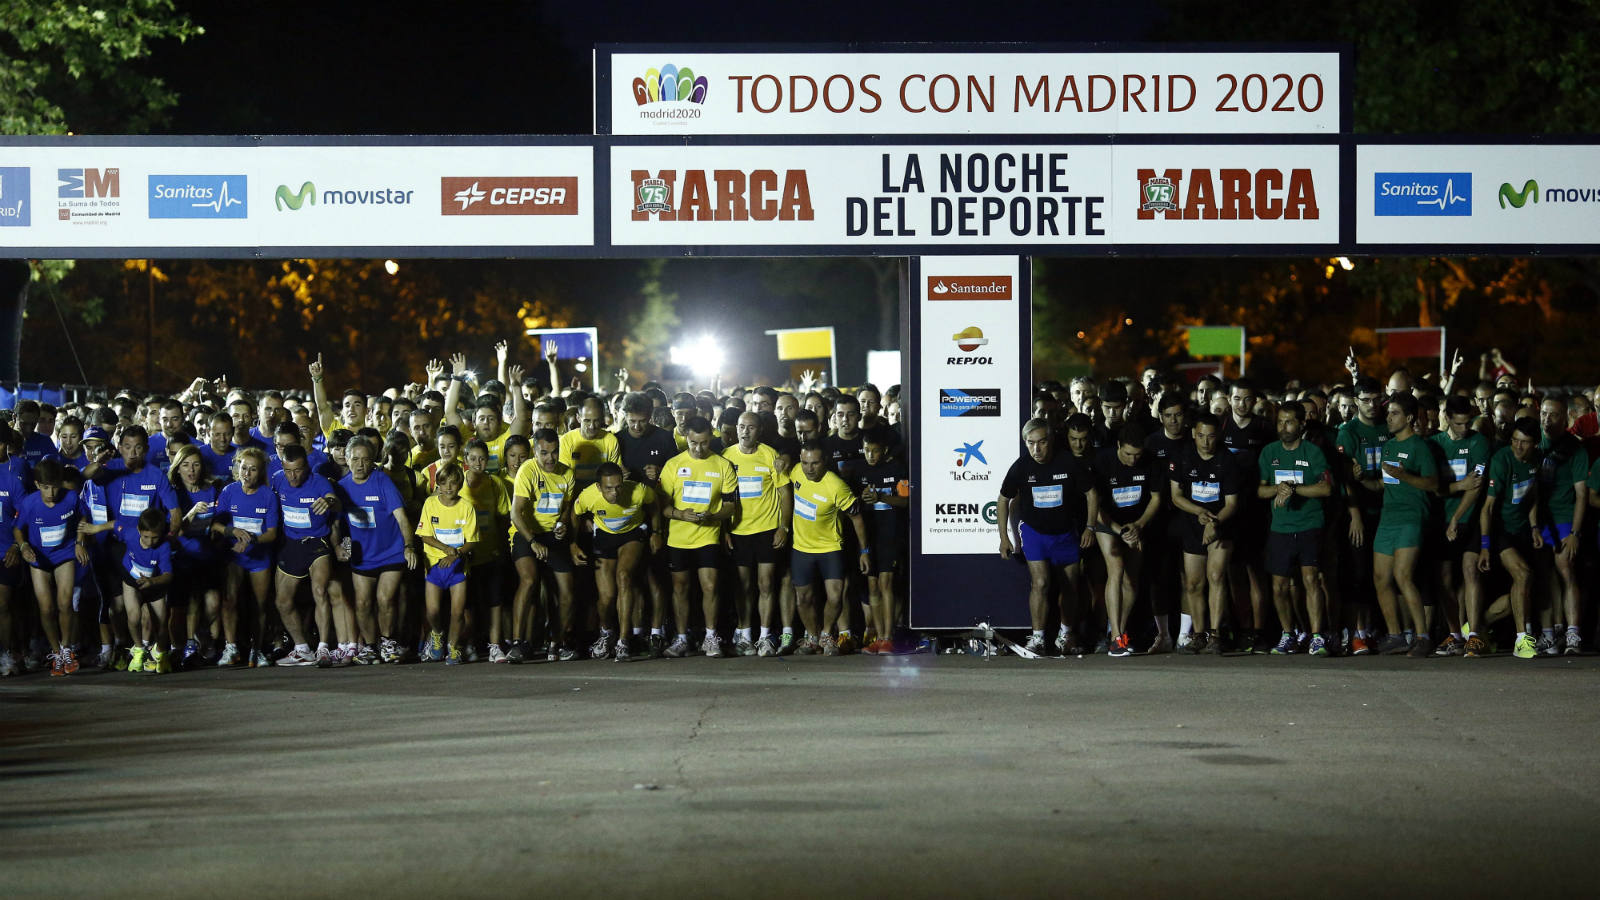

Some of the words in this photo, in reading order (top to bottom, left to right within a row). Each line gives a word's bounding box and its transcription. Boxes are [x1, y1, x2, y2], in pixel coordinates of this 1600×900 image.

[729, 74, 882, 113] TODOS
[900, 74, 994, 113] CON
[1014, 74, 1196, 112] MADRID
[1216, 74, 1323, 112] 2020
[641, 109, 701, 118] madrid2020
[882, 154, 924, 193] LA
[941, 153, 1068, 193] NOCHE
[155, 184, 213, 201] Sanitas
[324, 187, 414, 205] movistar
[490, 187, 567, 206] CEPSA
[631, 170, 814, 221] MARCA
[645, 188, 664, 203] 75
[1137, 169, 1319, 220] MARCA
[1151, 187, 1169, 202] 75
[1381, 181, 1439, 196] Sanitas
[1546, 188, 1600, 203] movi
[847, 197, 915, 236] DEL
[931, 197, 1105, 236] DEPORTE
[950, 282, 1007, 293] Santander
[947, 357, 993, 365] REPSOL
[935, 504, 979, 514] KERN
